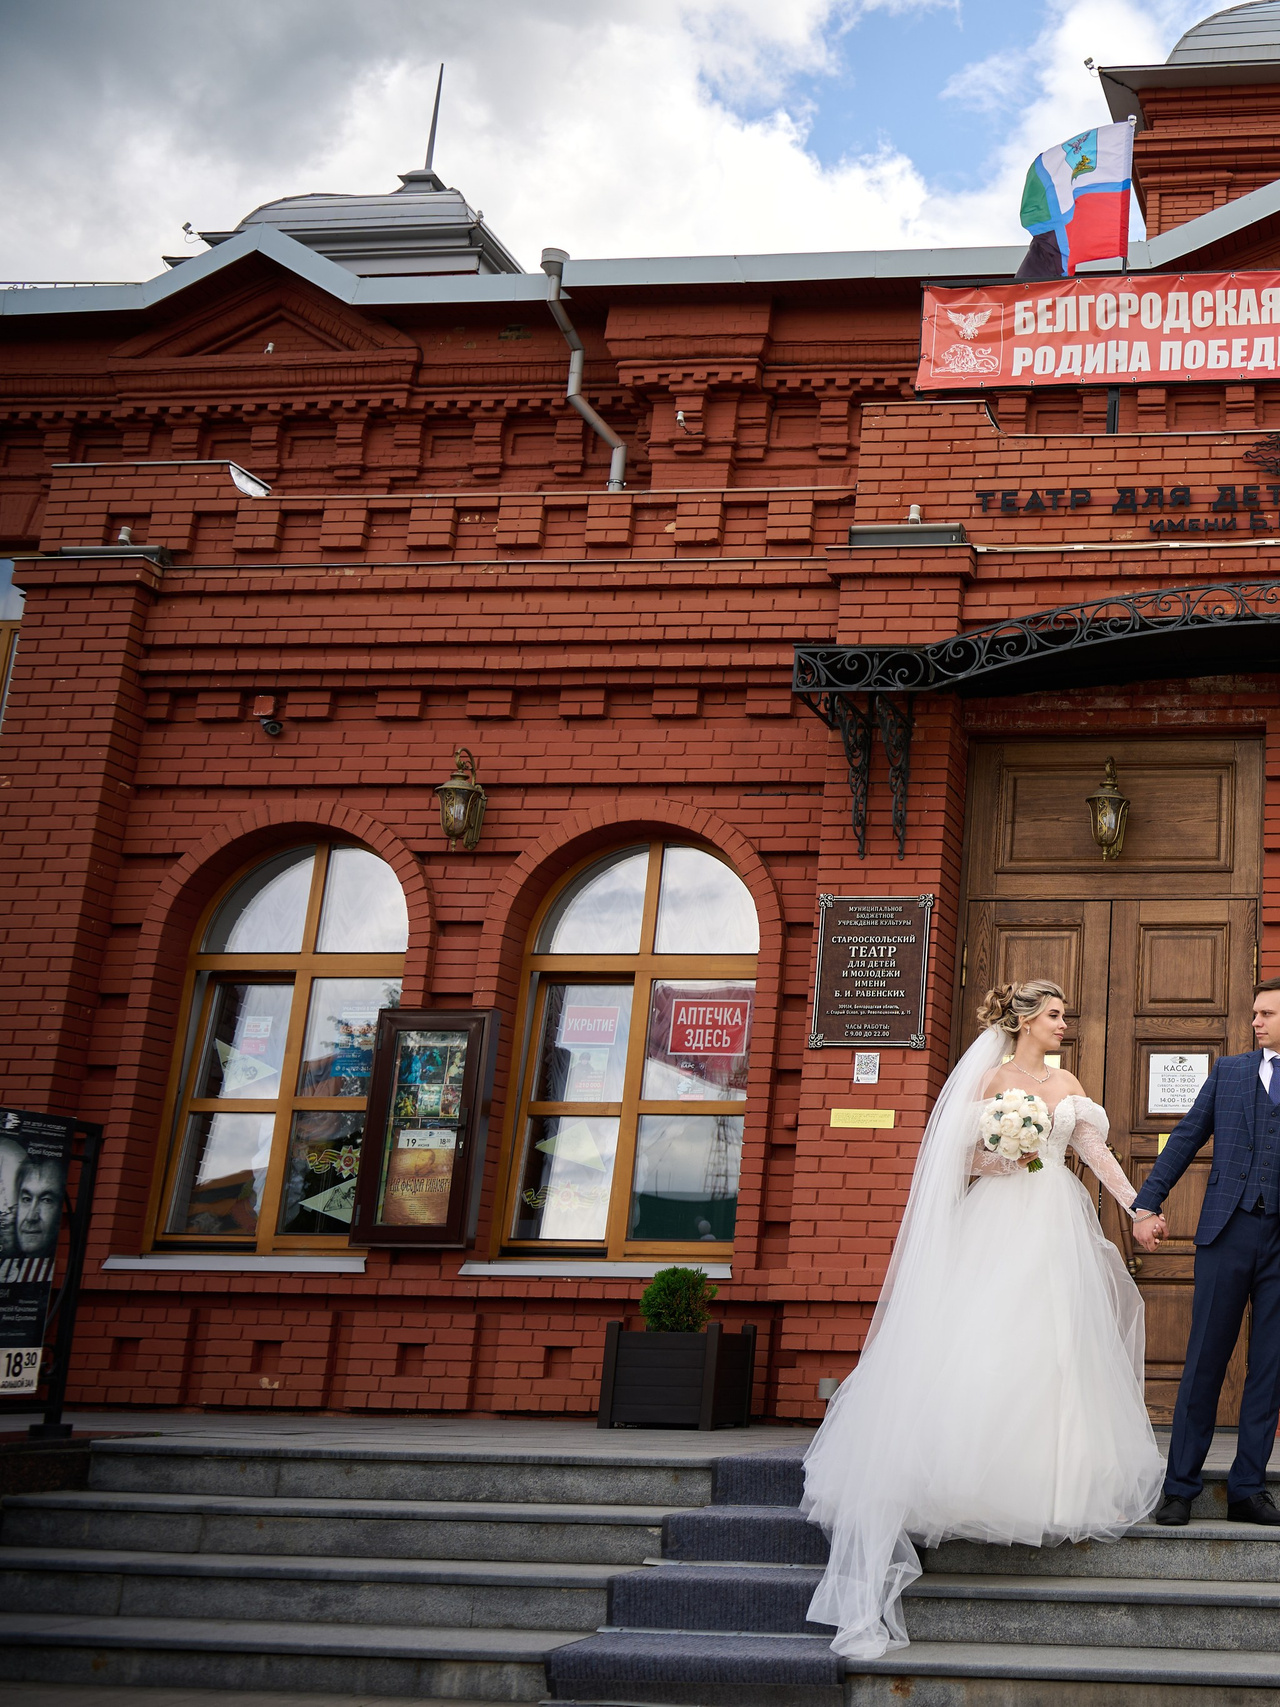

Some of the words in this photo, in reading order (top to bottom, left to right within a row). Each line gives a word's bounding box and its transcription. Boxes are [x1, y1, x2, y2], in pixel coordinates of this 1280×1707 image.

[1011, 340, 1151, 378] РОДИНА
[976, 489, 1091, 513] ТЕАТР
[1112, 487, 1191, 514] ДЛЯ
[831, 935, 916, 943] СТАРООСКОЛЬСКИЙ
[848, 946, 897, 958] ТЕАТР
[847, 960, 866, 969] ДЛЯ
[867, 959, 896, 969] ДЕТЕЙ
[842, 970, 848, 978] И
[850, 969, 901, 978] МОЛОДЁЖИ
[834, 990, 842, 998] Б.
[844, 990, 853, 998] И.
[856, 990, 905, 998] РАВЕНСКИХ
[677, 1006, 742, 1026] АПТЕЧКА
[567, 1017, 615, 1032] УКРЫТИЕ
[684, 1029, 731, 1050] ЗДЕСЬ
[406, 1138, 417, 1147] 19
